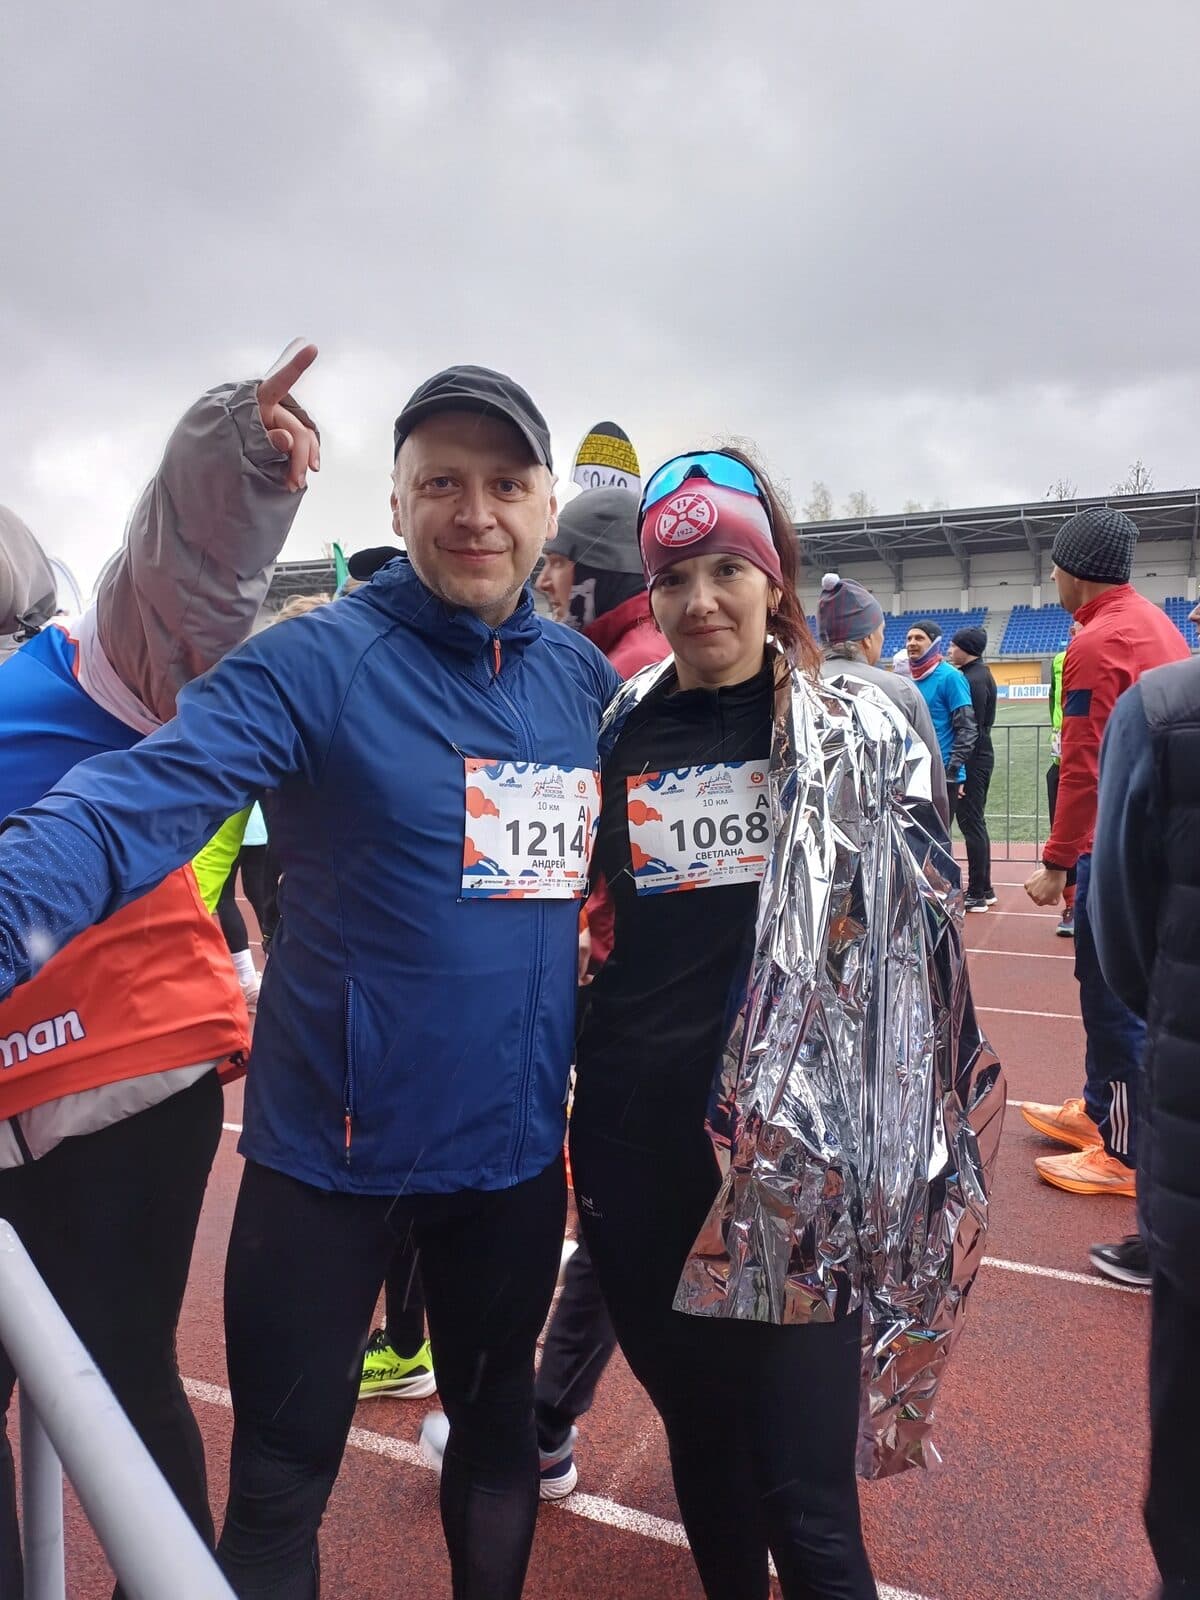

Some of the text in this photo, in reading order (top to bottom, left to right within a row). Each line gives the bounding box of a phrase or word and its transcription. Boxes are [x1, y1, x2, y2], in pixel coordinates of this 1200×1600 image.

[695, 507, 706, 518] S
[537, 801, 548, 811] 10
[702, 798, 714, 807] 10
[669, 811, 770, 852] 1068
[505, 819, 584, 858] 1214
[695, 847, 745, 861] СВЕТЛАНА
[532, 858, 566, 869] АНДРЕЙ
